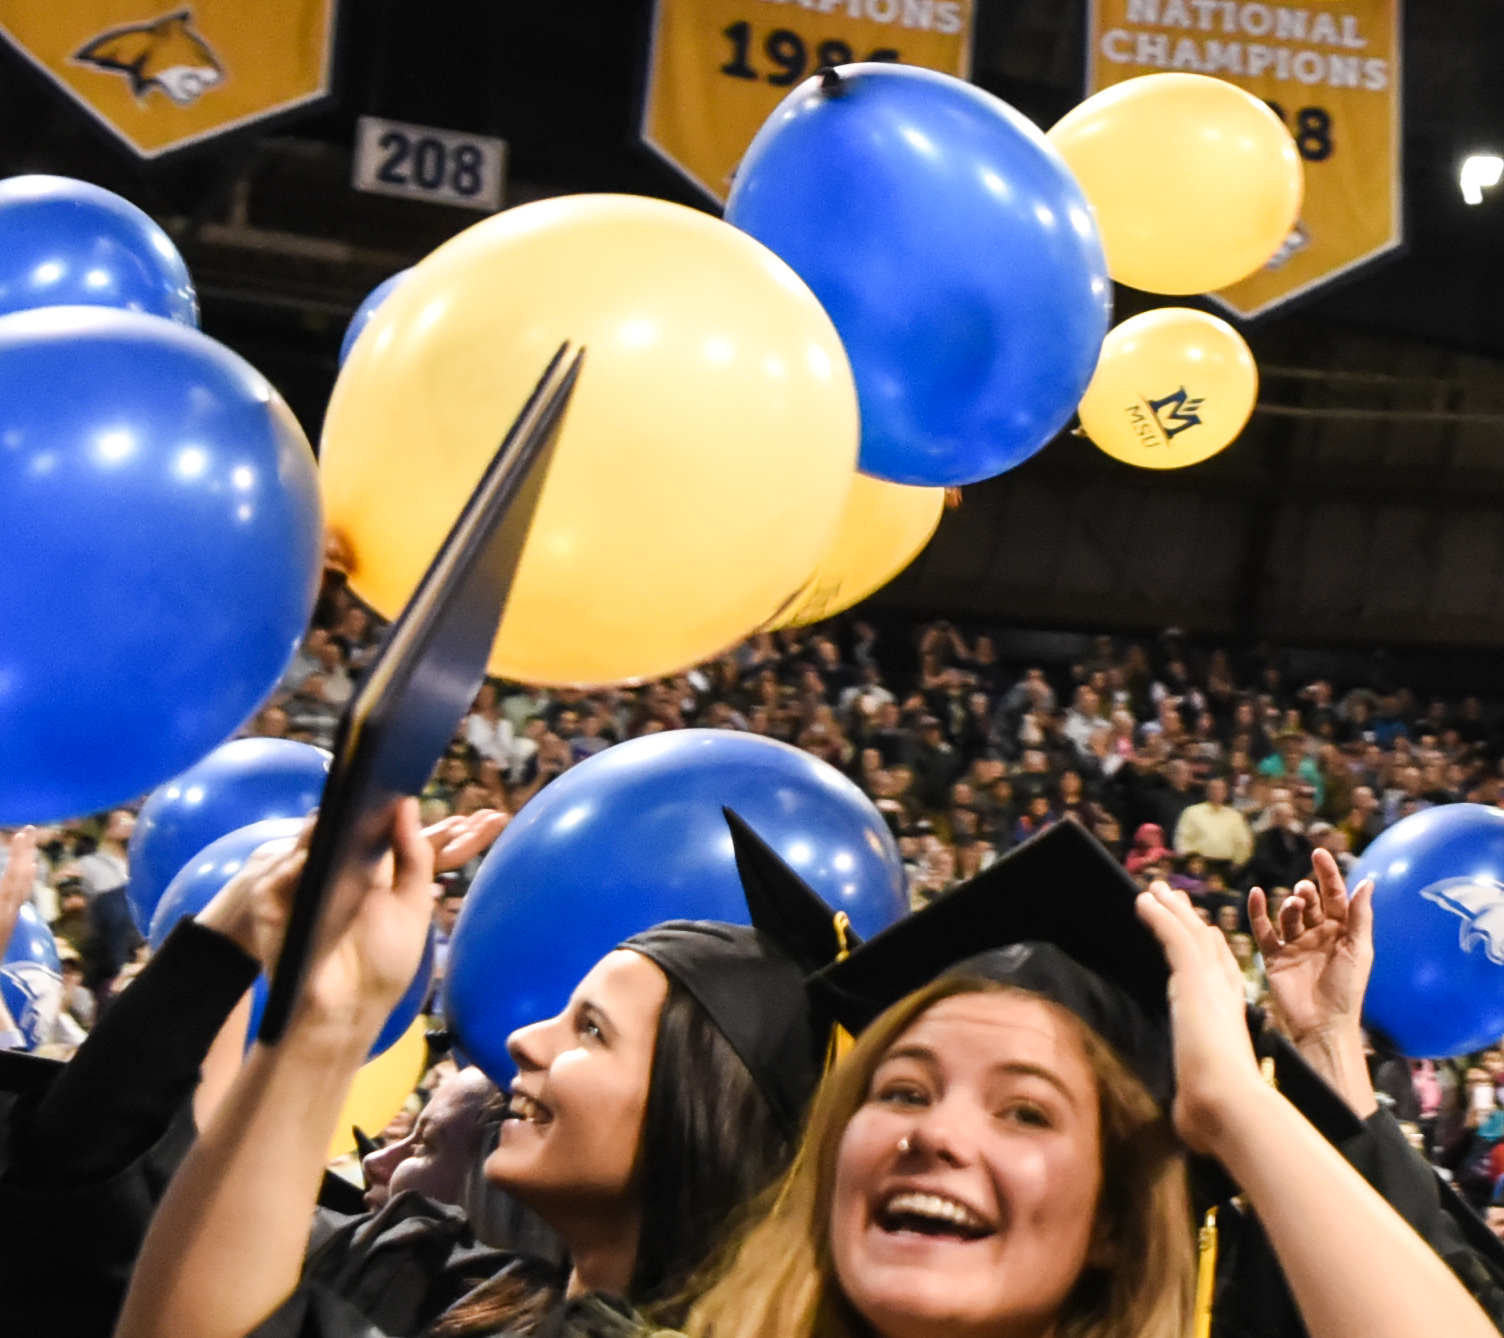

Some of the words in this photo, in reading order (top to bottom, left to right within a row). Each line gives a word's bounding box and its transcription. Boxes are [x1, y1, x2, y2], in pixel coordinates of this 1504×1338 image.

[1100, 28, 1389, 92] CHAMPIONS
[376, 130, 484, 196] 208
[1124, 404, 1161, 448] MSU
